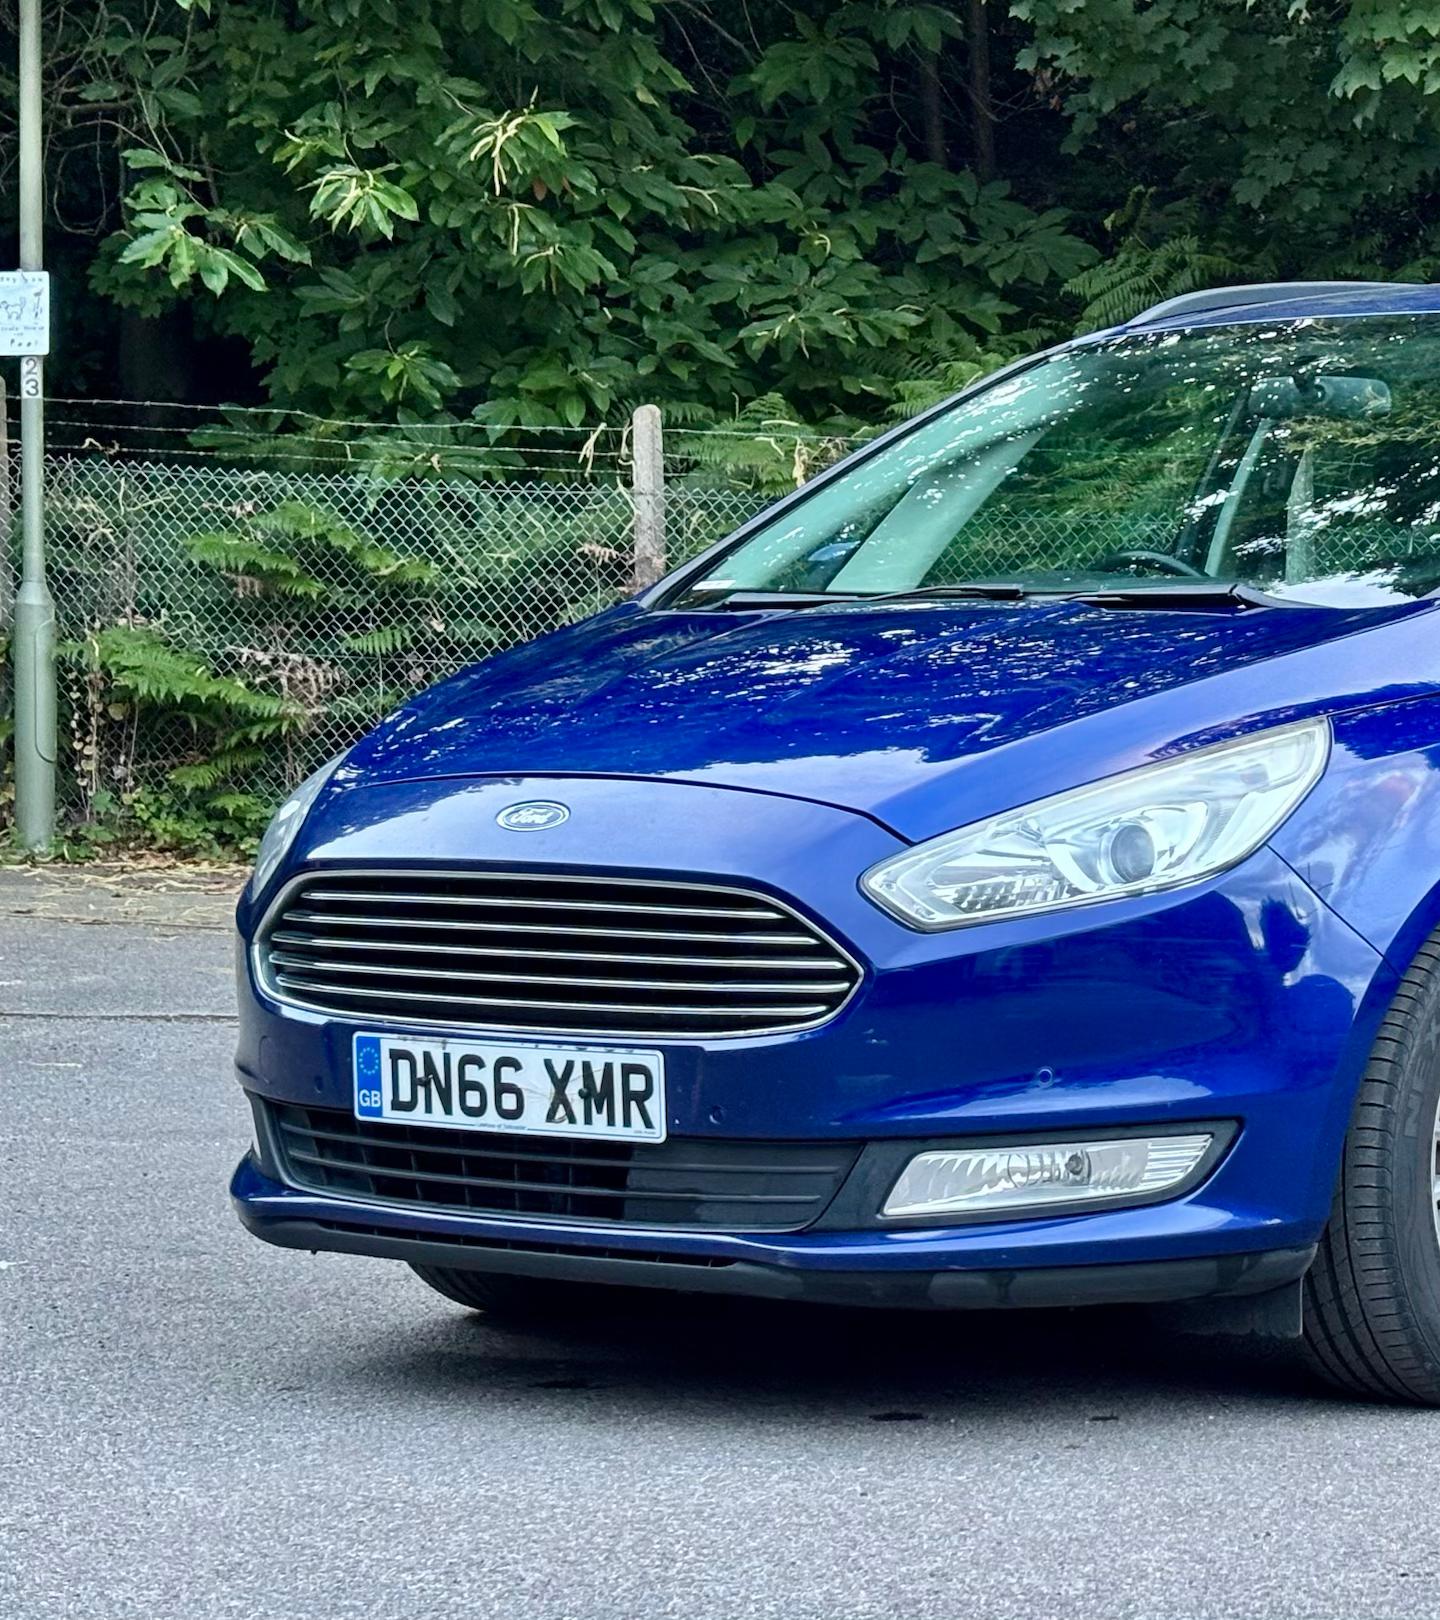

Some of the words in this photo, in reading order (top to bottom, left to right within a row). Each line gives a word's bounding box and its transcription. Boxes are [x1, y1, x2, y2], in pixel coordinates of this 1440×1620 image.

[509, 806, 555, 825] Ford
[358, 1089, 382, 1108] GB
[389, 1048, 525, 1121] DN66
[543, 1058, 656, 1130] XMR
